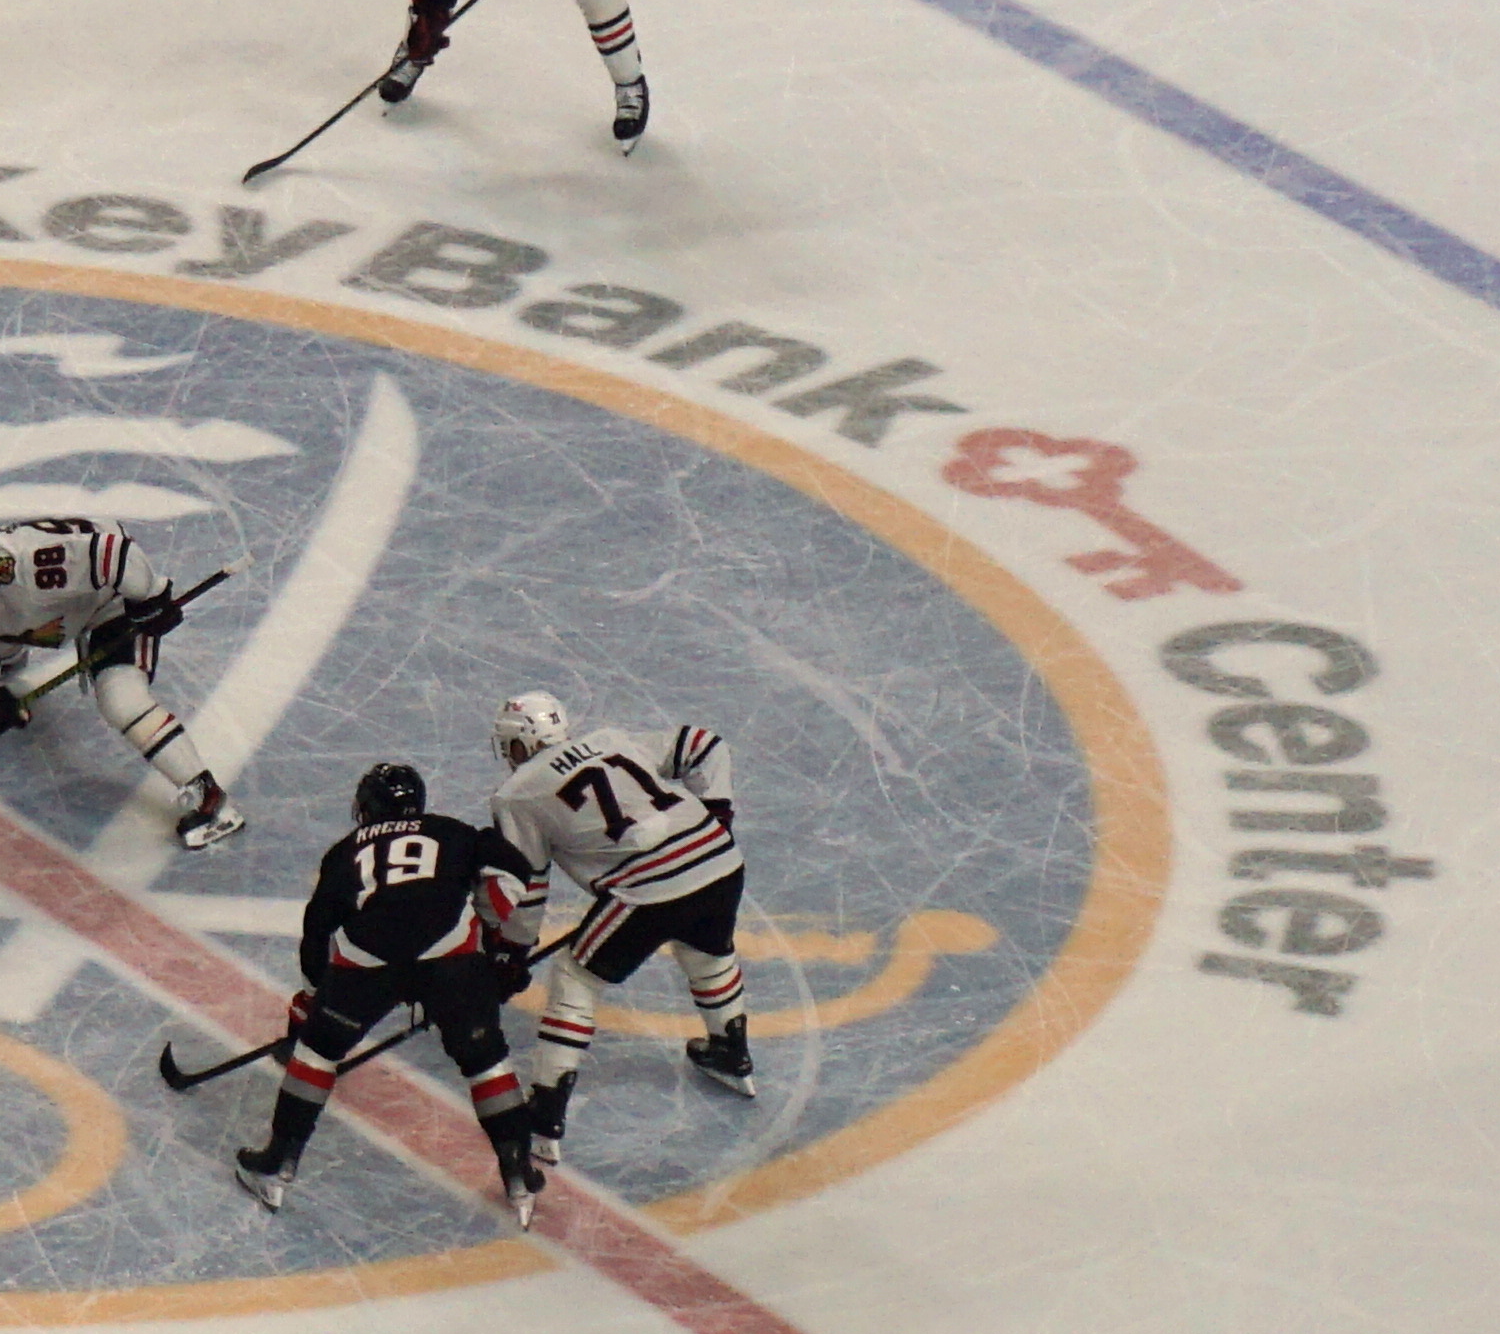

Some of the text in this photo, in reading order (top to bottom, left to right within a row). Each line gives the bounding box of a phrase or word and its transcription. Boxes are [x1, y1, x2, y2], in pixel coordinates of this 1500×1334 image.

[550, 743, 604, 776] HALL
[556, 753, 685, 842] 71
[355, 818, 423, 845] KREBS
[1157, 618, 1441, 1018] Center
[353, 834, 440, 912] 19
